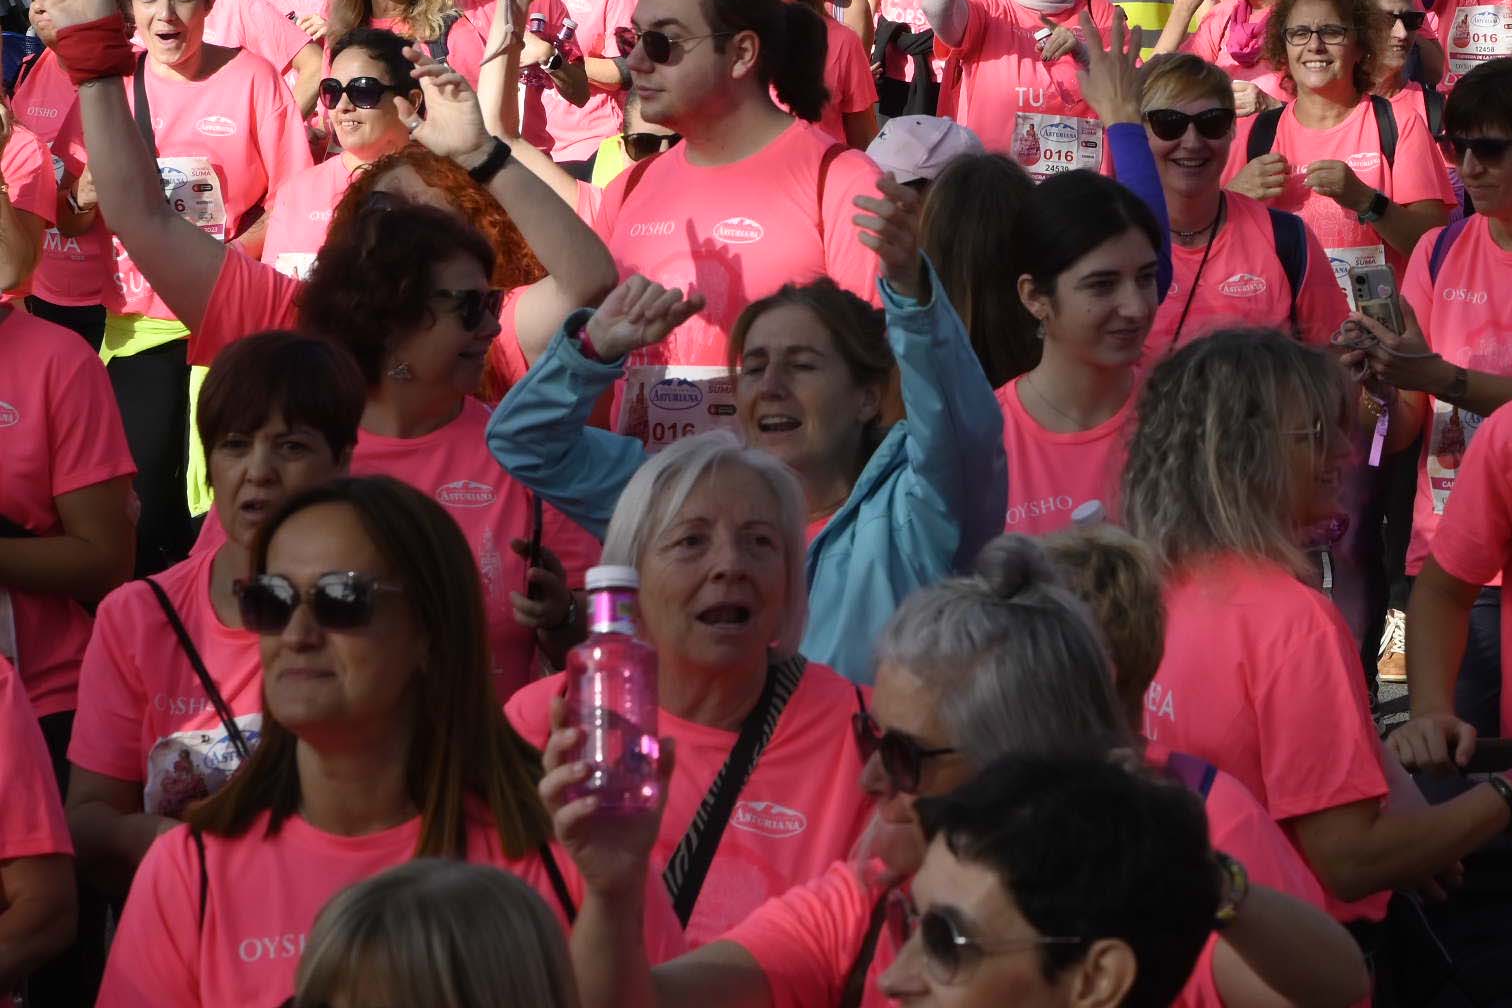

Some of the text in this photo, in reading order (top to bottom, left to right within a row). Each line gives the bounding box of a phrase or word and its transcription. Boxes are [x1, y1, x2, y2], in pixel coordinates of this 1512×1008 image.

[1472, 33, 1498, 43] 016
[1015, 87, 1044, 107] TU
[1043, 148, 1074, 162] 016
[629, 222, 675, 237] OYSHO
[1222, 282, 1265, 293] ASTURIANA
[651, 390, 698, 403] ASTURIANA
[652, 422, 695, 441] 016
[440, 490, 496, 503] ASTURIANA
[1006, 496, 1073, 525] OYSHO
[734, 812, 802, 830] ASTURIANA
